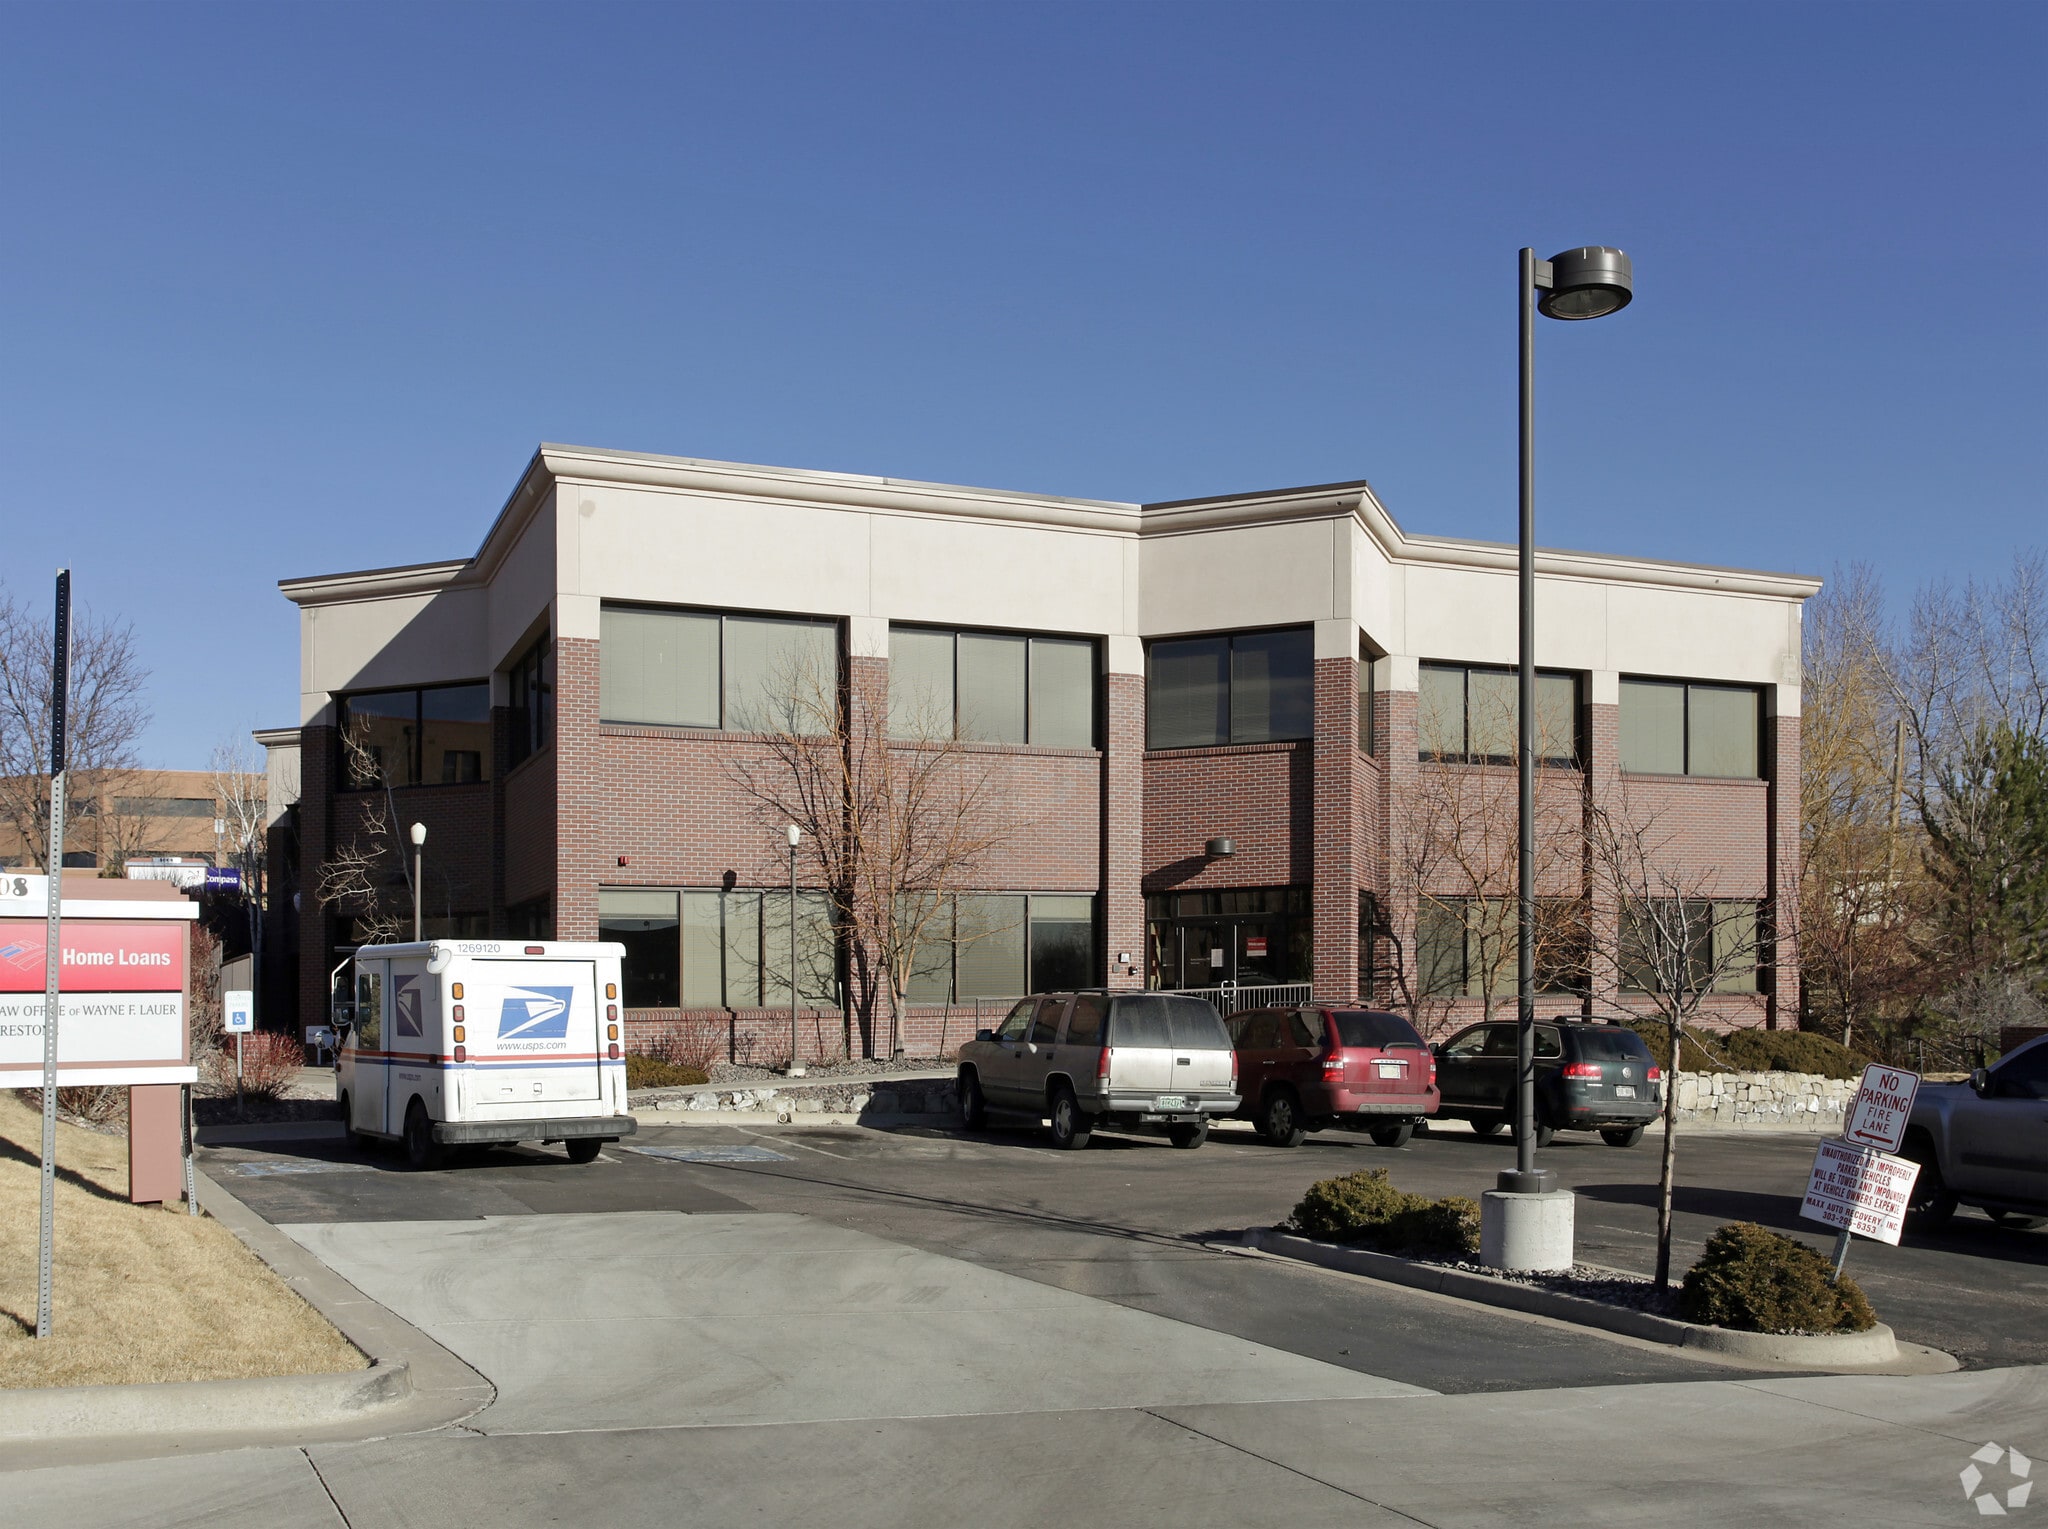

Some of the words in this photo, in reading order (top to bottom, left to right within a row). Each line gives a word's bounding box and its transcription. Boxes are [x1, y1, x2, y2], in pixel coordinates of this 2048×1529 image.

[62, 948, 114, 966] Home
[118, 948, 171, 966] Loans
[457, 943, 501, 953] 1269120
[23, 1005, 66, 1017] OFFE
[69, 1008, 81, 1016] OF
[82, 1004, 125, 1016] WAYNE
[140, 1004, 177, 1015] LAUER
[496, 1041, 567, 1052] www.usps.com
[1879, 1074, 1900, 1091] NO
[1860, 1088, 1908, 1112] PARKING
[1867, 1107, 1893, 1122] FIRE
[1863, 1119, 1890, 1134] LANE
[1822, 1147, 1864, 1166] UNAUTHORIZED
[1865, 1159, 1875, 1168] OR
[1876, 1162, 1912, 1180] IMPROPERLY
[1837, 1162, 1860, 1177] PARKED
[1861, 1169, 1891, 1187] VEHICLES
[1814, 1169, 1826, 1180] WILL
[1828, 1172, 1836, 1182] BE
[1839, 1174, 1857, 1188] TOWED
[1858, 1181, 1873, 1193] AND
[1874, 1187, 1906, 1204] IMPOUNDED
[1807, 1197, 1825, 1209] MAXX
[1827, 1203, 1844, 1215] AUTO
[1814, 1181, 1822, 1192] AT
[1823, 1184, 1846, 1198] VEHICLE
[1846, 1189, 1873, 1205] OWNERS
[1874, 1198, 1900, 1215] EXPENSE
[1822, 1211, 1877, 1233] 303-295-6353
